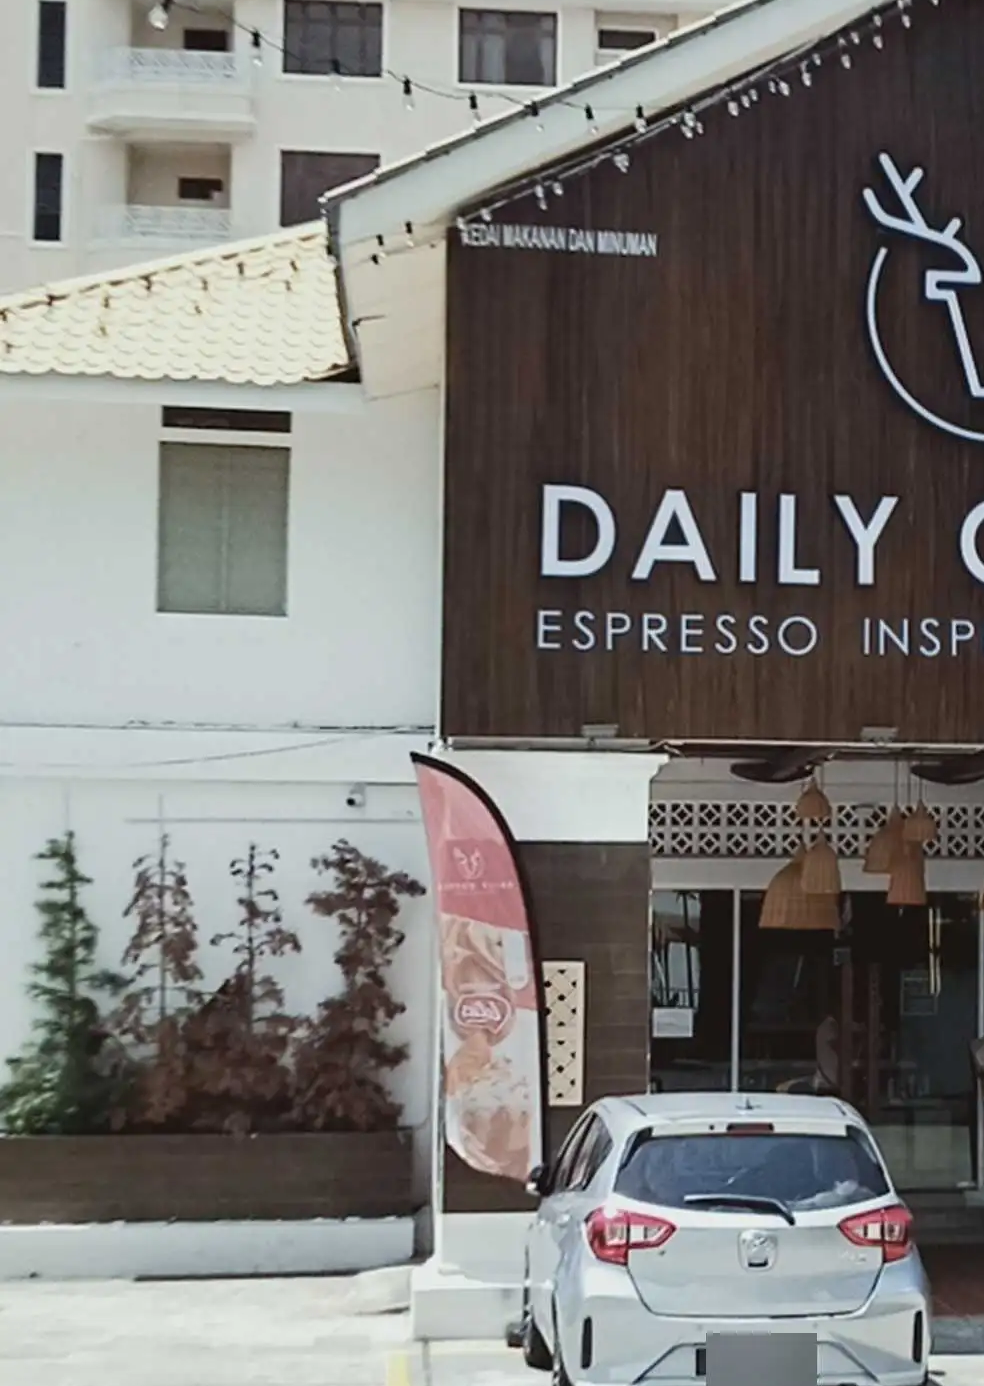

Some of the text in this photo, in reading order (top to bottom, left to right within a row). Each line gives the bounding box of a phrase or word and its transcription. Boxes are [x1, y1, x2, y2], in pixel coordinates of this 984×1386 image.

[503, 225, 566, 250] MAKANAN
[568, 228, 595, 253] DAN
[597, 230, 657, 257] MINUMAN
[541, 484, 898, 585] DAILY
[537, 610, 817, 657] ESPRESSO
